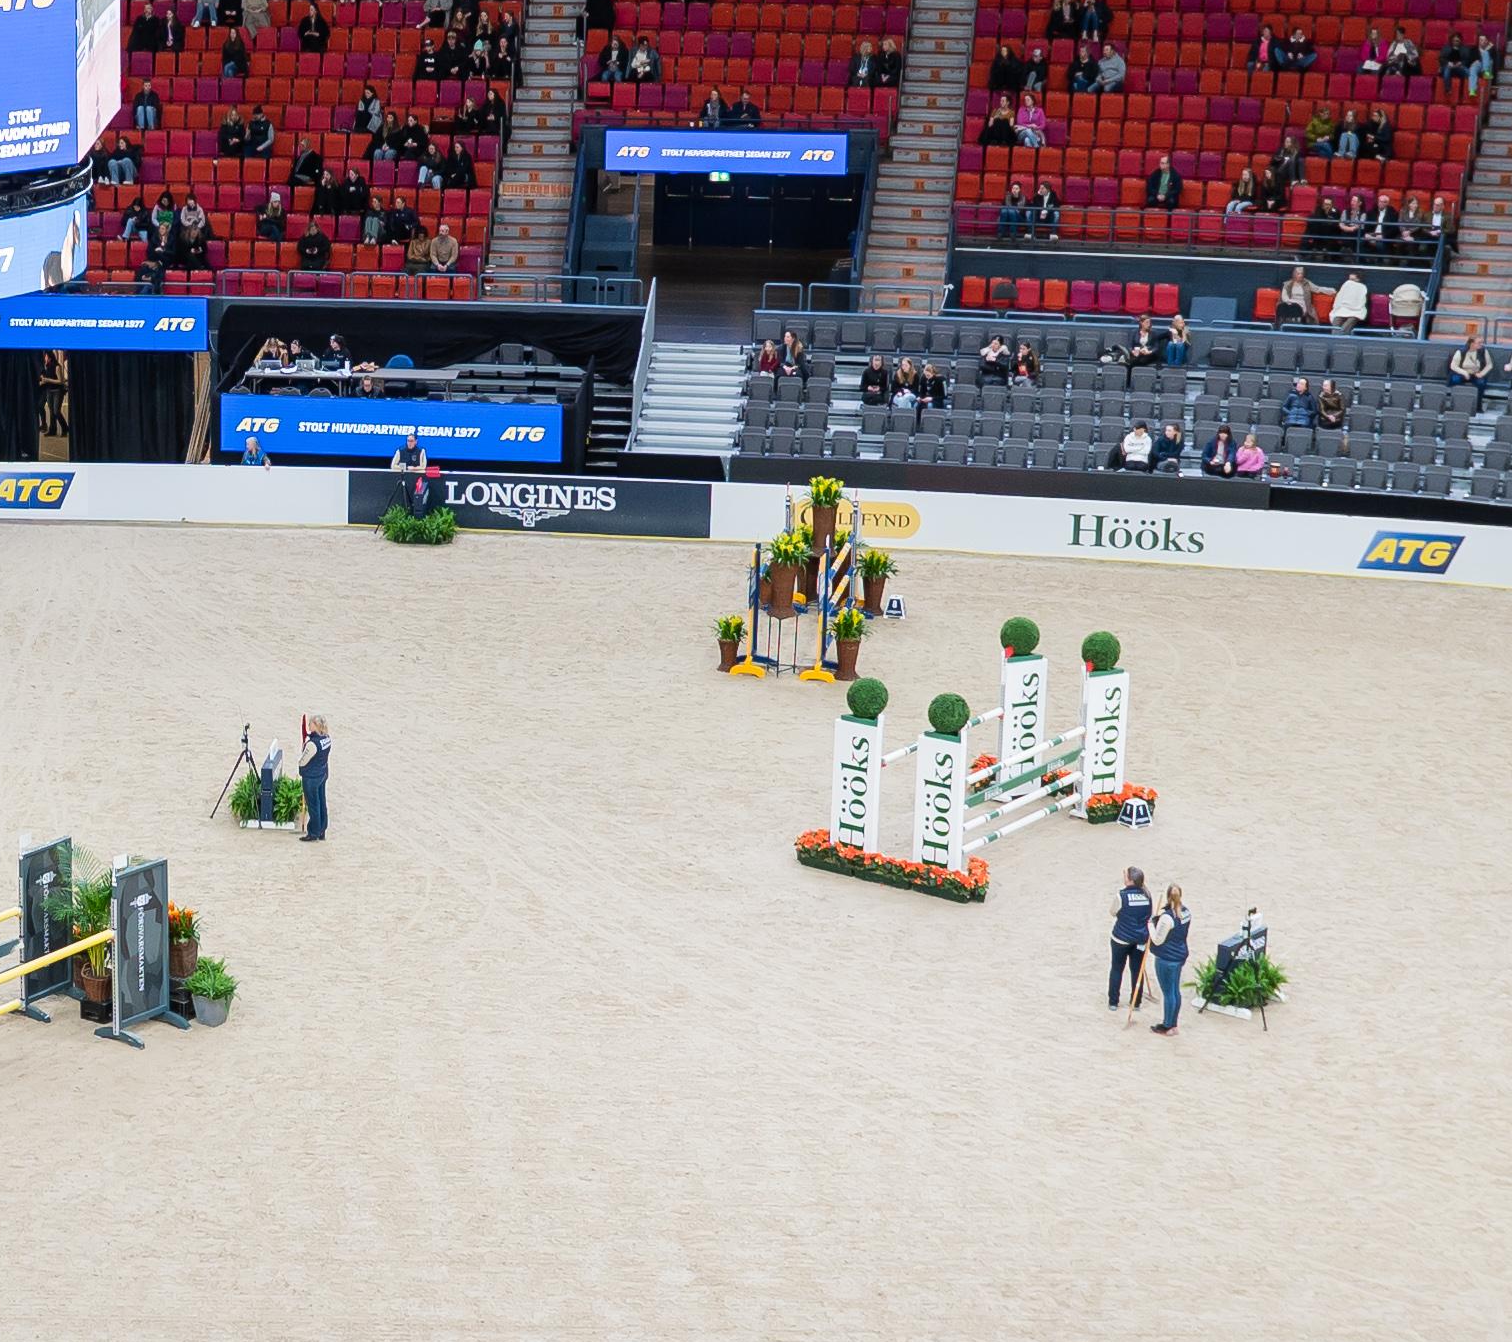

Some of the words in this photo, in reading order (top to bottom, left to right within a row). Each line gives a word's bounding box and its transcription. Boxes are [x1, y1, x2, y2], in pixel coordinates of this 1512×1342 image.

[8, 108, 42, 125] STOLT
[32, 139, 60, 155] 1977
[617, 145, 650, 159] ATG
[661, 148, 684, 158] STOLT
[745, 149, 772, 159] SEDAN
[800, 149, 835, 163] ATG
[9, 318, 34, 327] STOLT
[98, 319, 124, 328] SEDAN
[154, 317, 195, 332] ATG
[236, 417, 280, 433] ATG
[298, 421, 330, 433] STOLT
[331, 423, 416, 436] HUVUDPARTNER
[418, 426, 453, 438] SEDAN
[454, 426, 480, 438] 1977
[499, 426, 545, 442] ATG
[446, 480, 617, 512] LONGINES
[1068, 513, 1205, 554] Hööks
[1365, 536, 1455, 568] ATG
[1092, 686, 1122, 795] Hööks
[838, 735, 870, 850] Hööks
[921, 751, 954, 868] Hööks
[137, 905, 146, 993] FÖRSVARSMAKTEN
